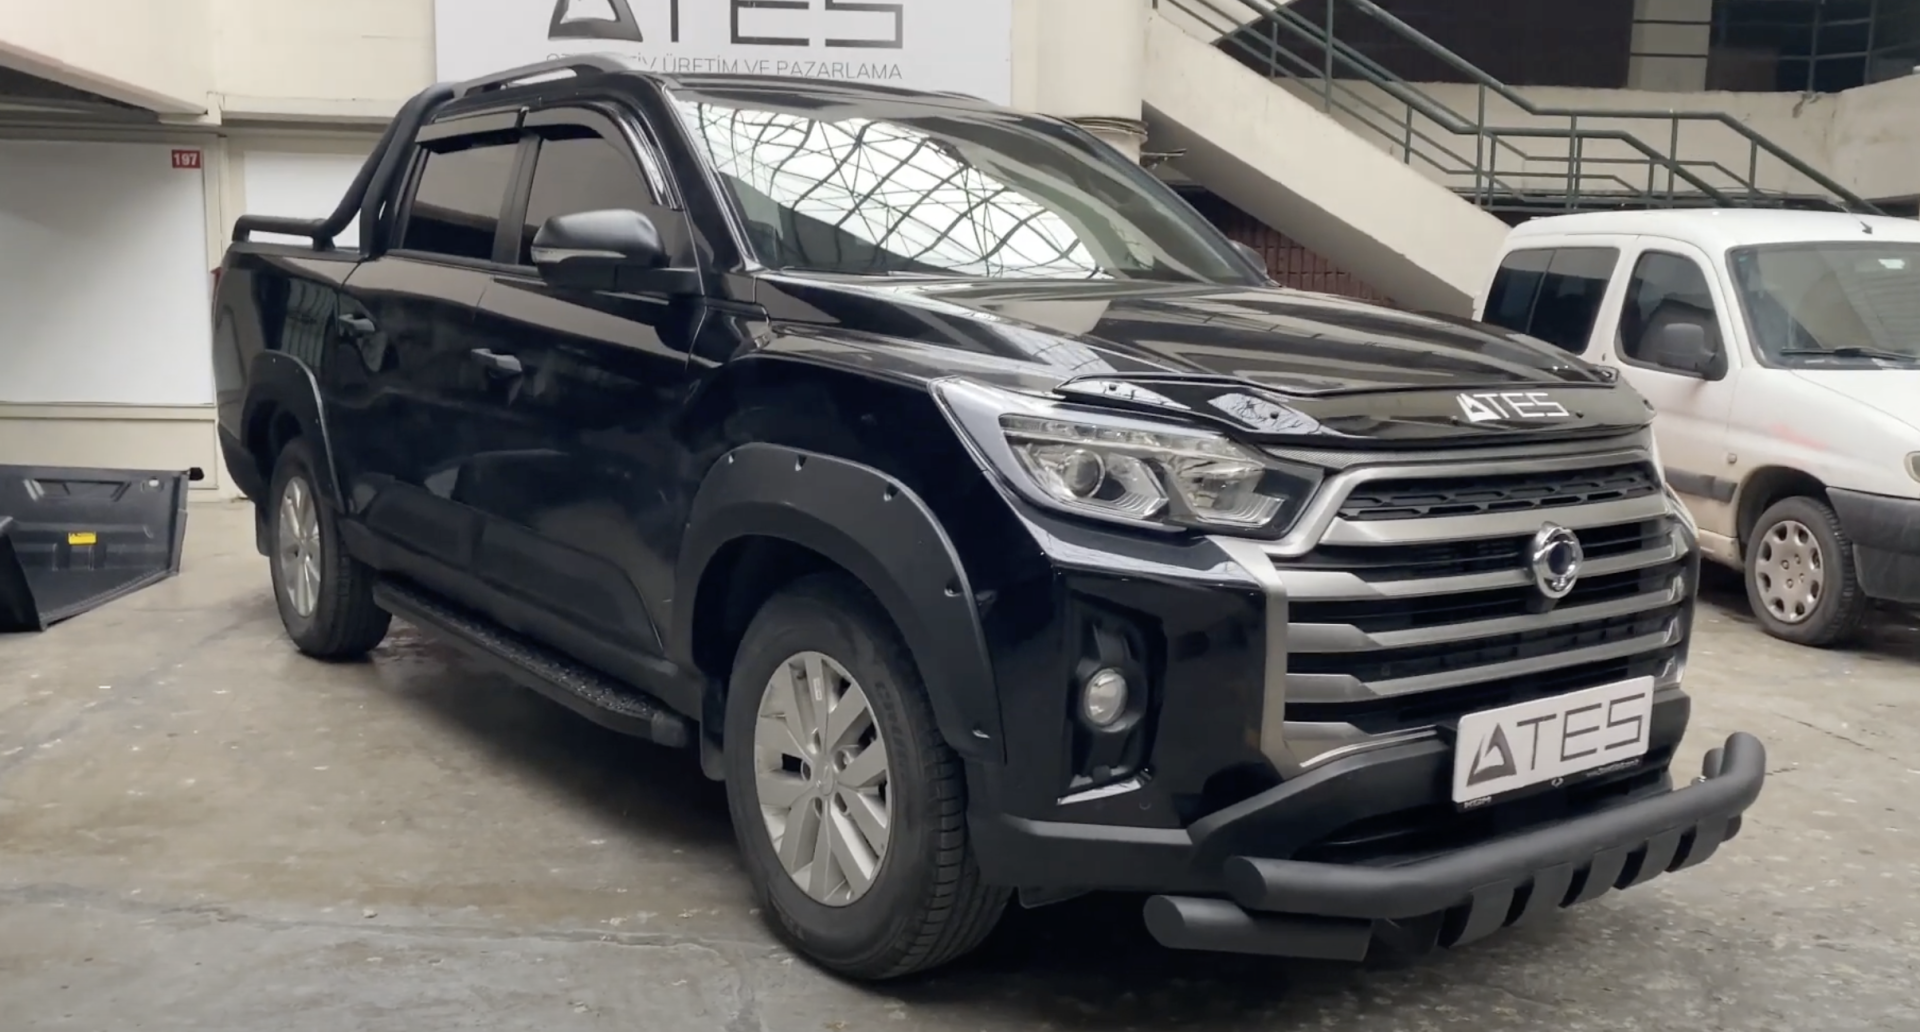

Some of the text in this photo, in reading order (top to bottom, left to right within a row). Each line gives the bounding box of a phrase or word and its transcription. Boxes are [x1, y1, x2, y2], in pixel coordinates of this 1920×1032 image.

[662, 53, 738, 73] ÜRETİM
[743, 59, 770, 74] VE
[777, 60, 903, 80] PAZARLAMA
[173, 152, 198, 166] 197
[1456, 393, 1570, 422] ATES
[1466, 692, 1646, 787] ATES
